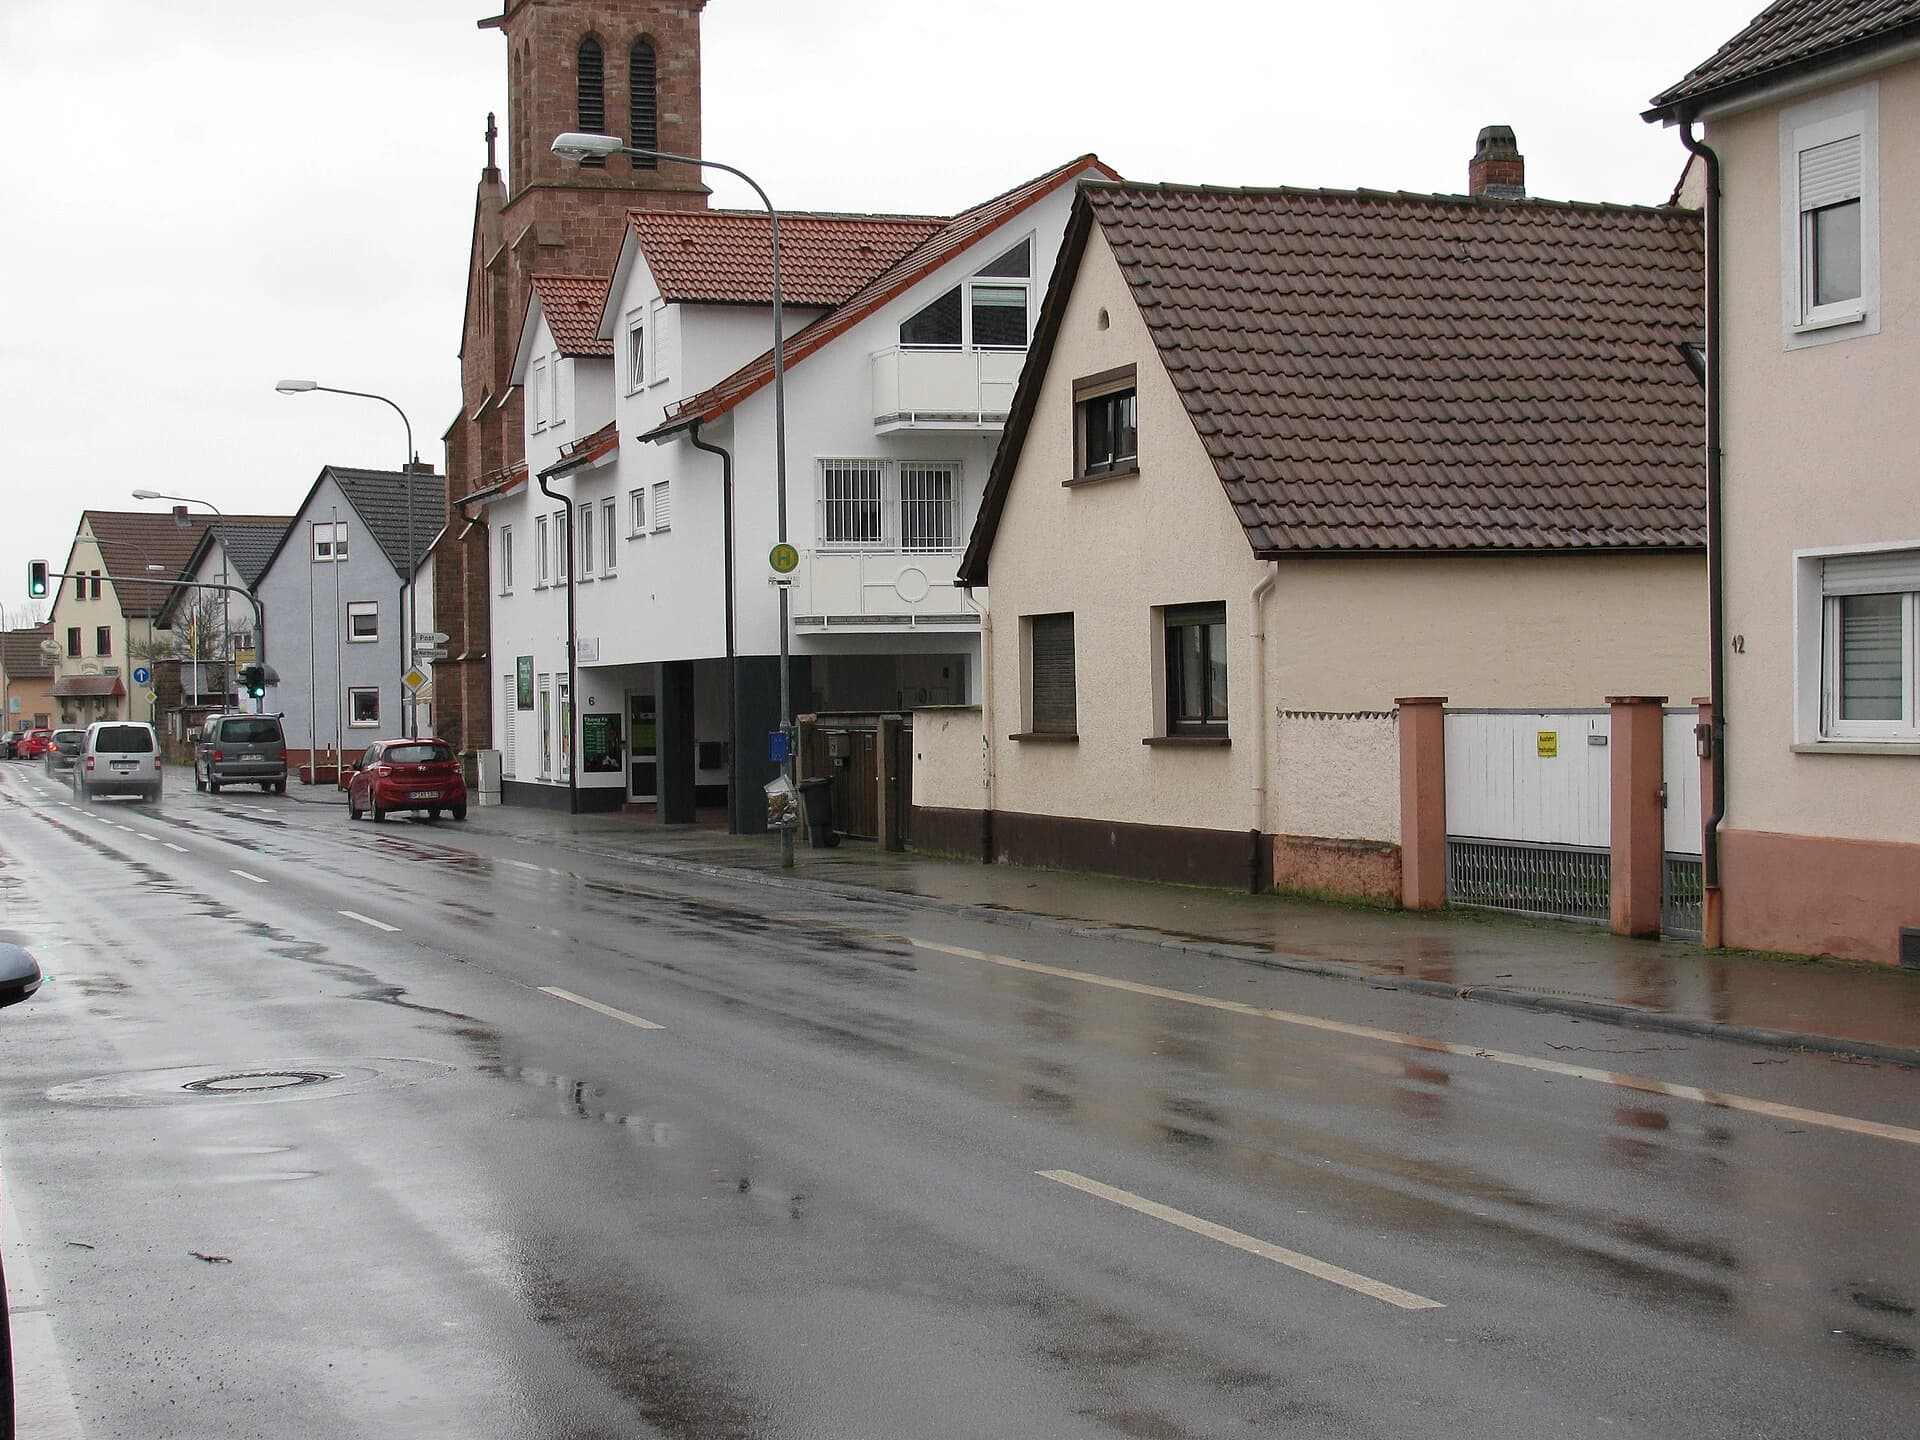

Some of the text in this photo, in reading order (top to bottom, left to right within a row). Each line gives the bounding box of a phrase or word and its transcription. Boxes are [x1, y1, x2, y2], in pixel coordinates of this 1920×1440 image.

[776, 552, 791, 565] H
[1731, 634, 1746, 654] 12
[588, 696, 595, 706] 6
